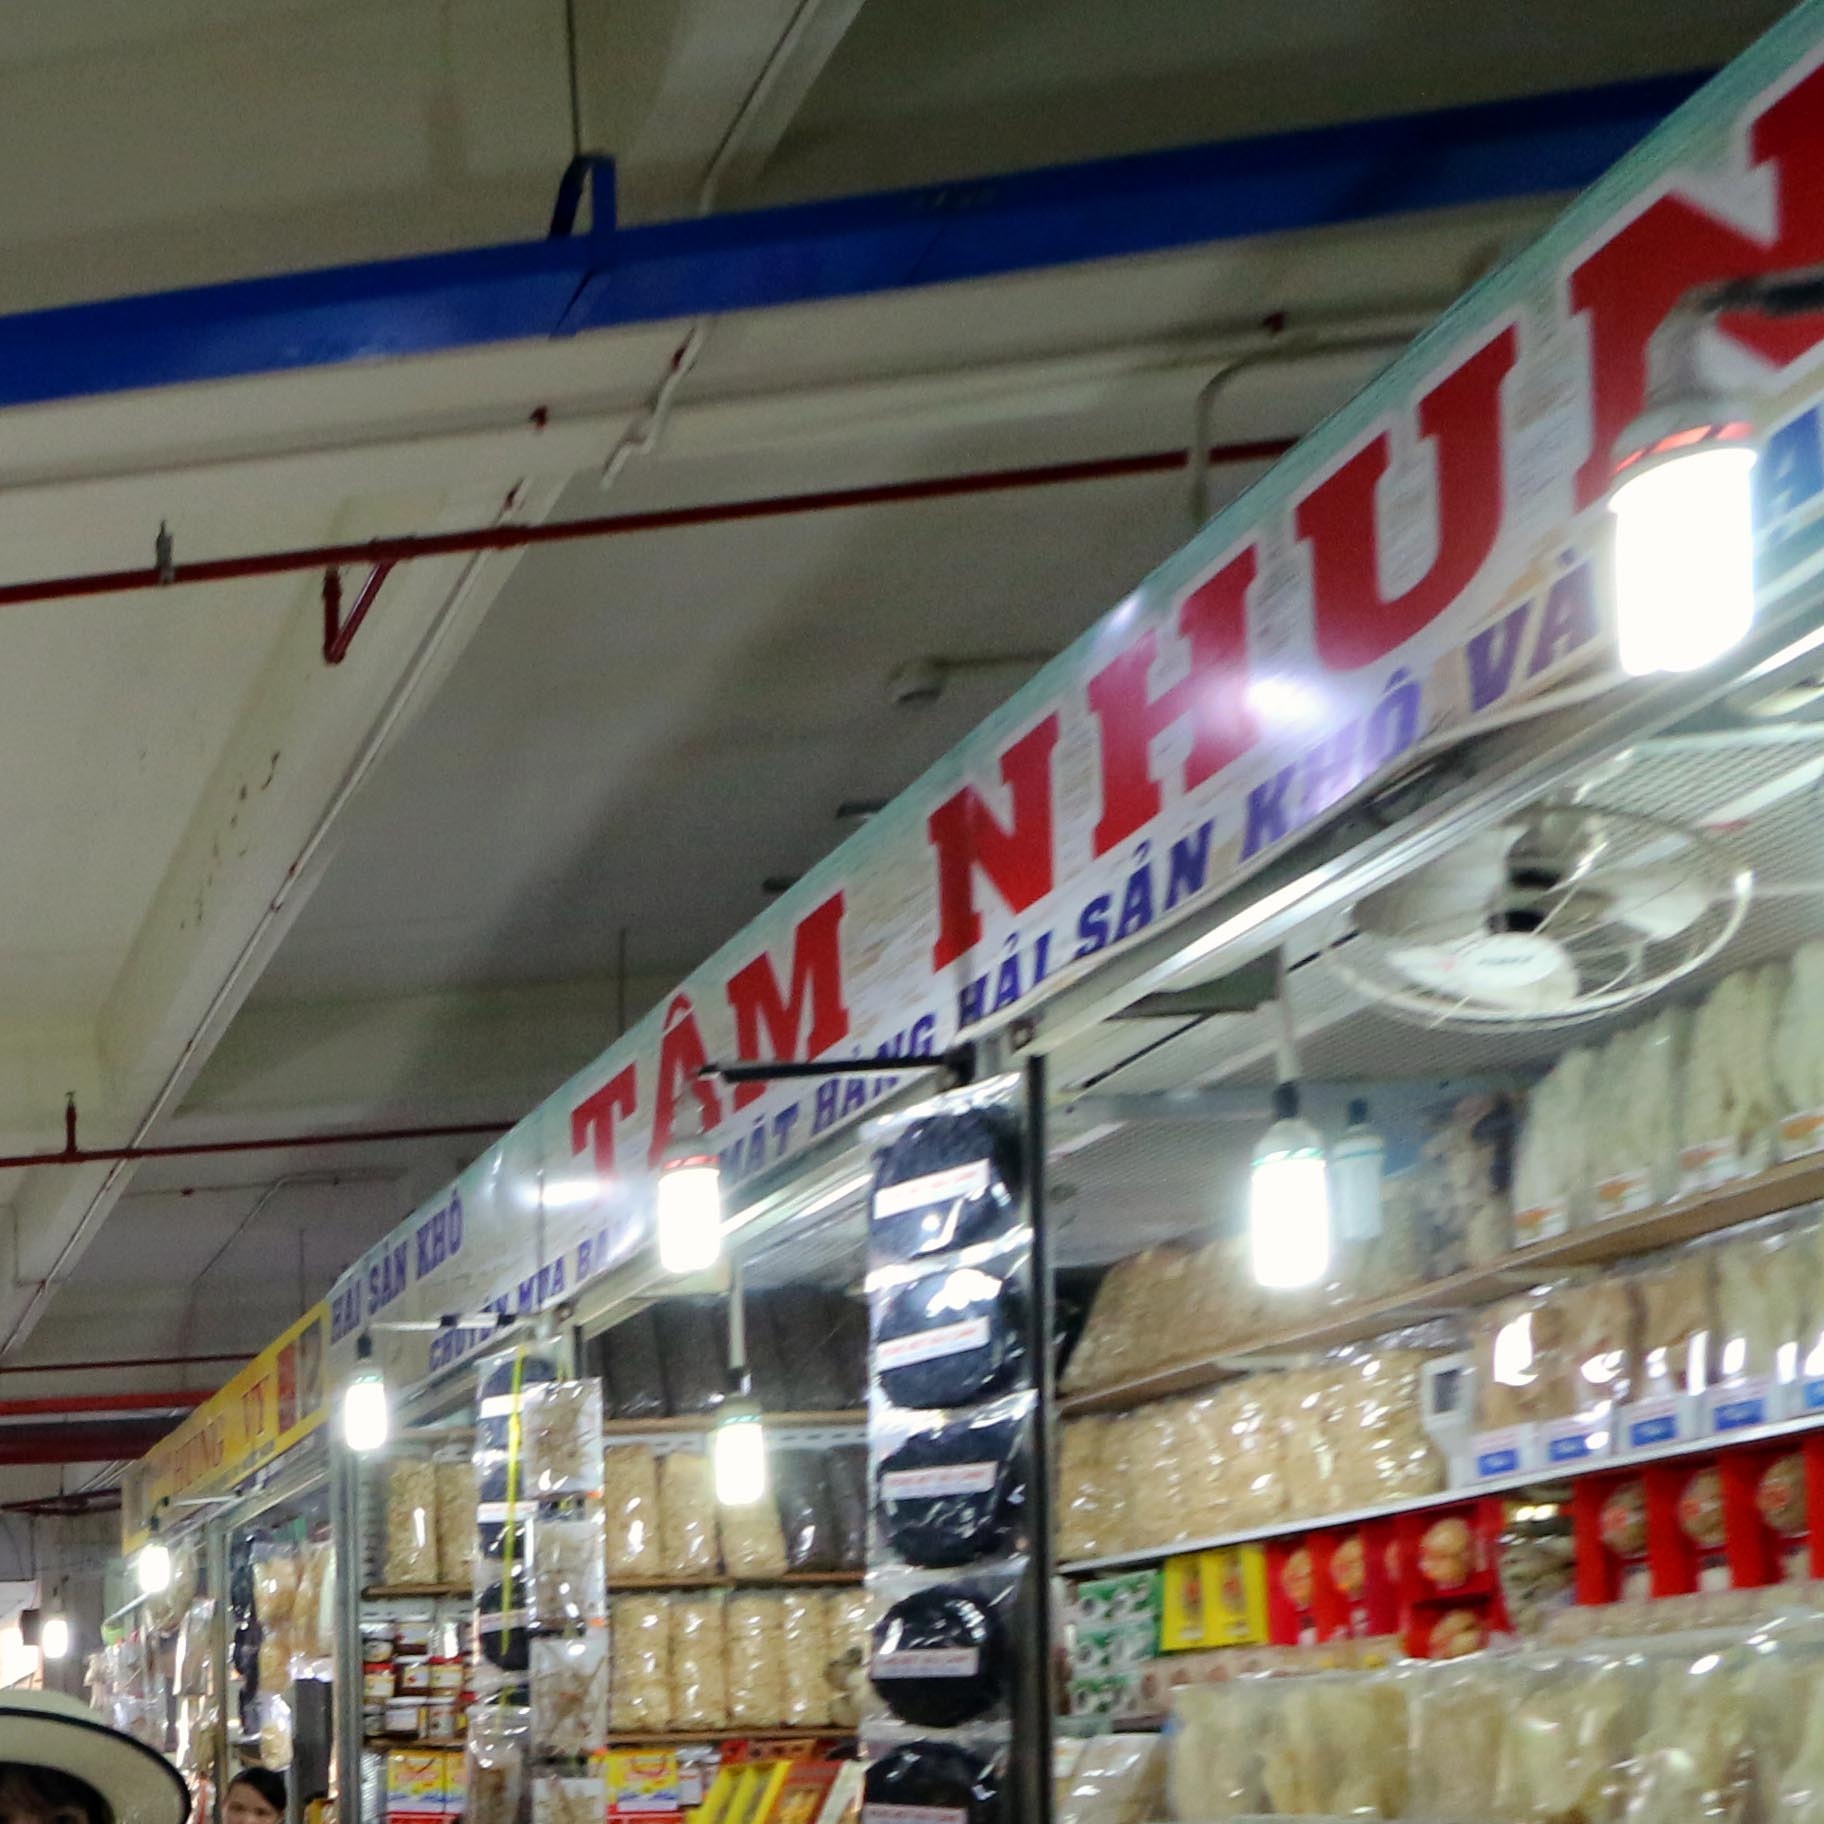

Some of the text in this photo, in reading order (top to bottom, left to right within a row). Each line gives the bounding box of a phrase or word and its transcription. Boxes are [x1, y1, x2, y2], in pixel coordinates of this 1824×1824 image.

[957, 930, 1054, 1027] HẢI
[1072, 840, 1214, 964] SẢN
[1238, 664, 1424, 864] KHÔ
[368, 1238, 408, 1315] SẢN
[517, 1254, 567, 1316] MUA
